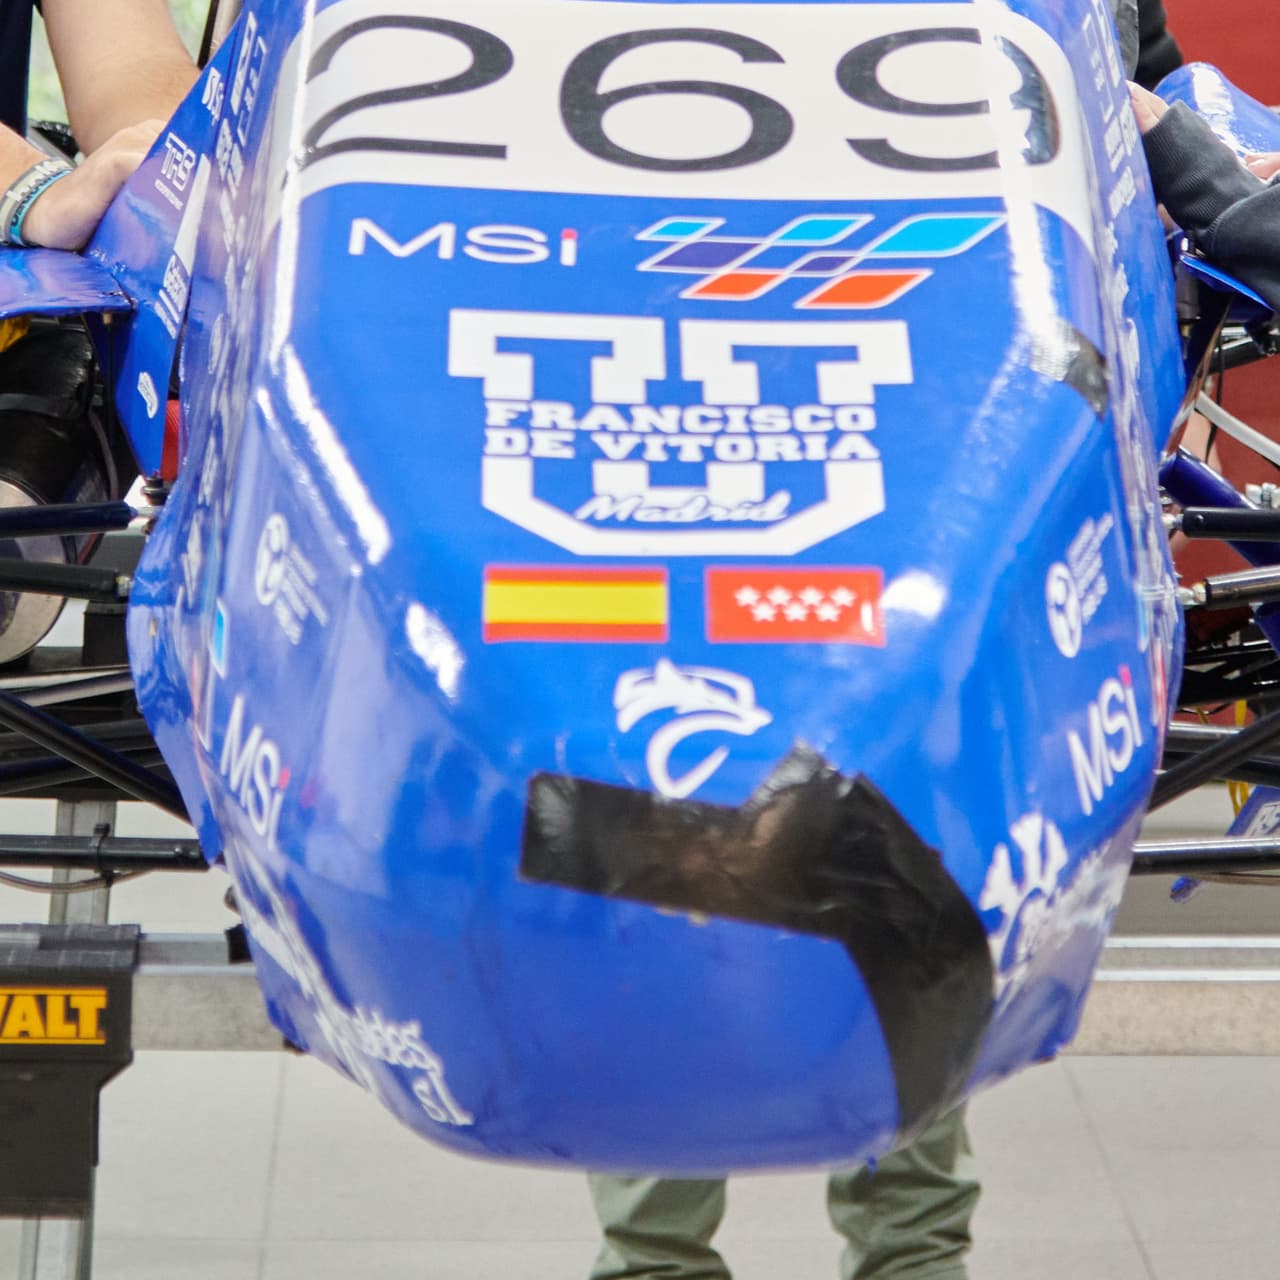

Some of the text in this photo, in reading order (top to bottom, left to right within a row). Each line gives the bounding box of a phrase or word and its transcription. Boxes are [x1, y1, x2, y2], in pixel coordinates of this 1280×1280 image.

[293, 14, 1061, 173] 269
[484, 399, 877, 434] FRANCISCO
[484, 426, 880, 462] DE VITORIA
[575, 489, 792, 524] Madrid
